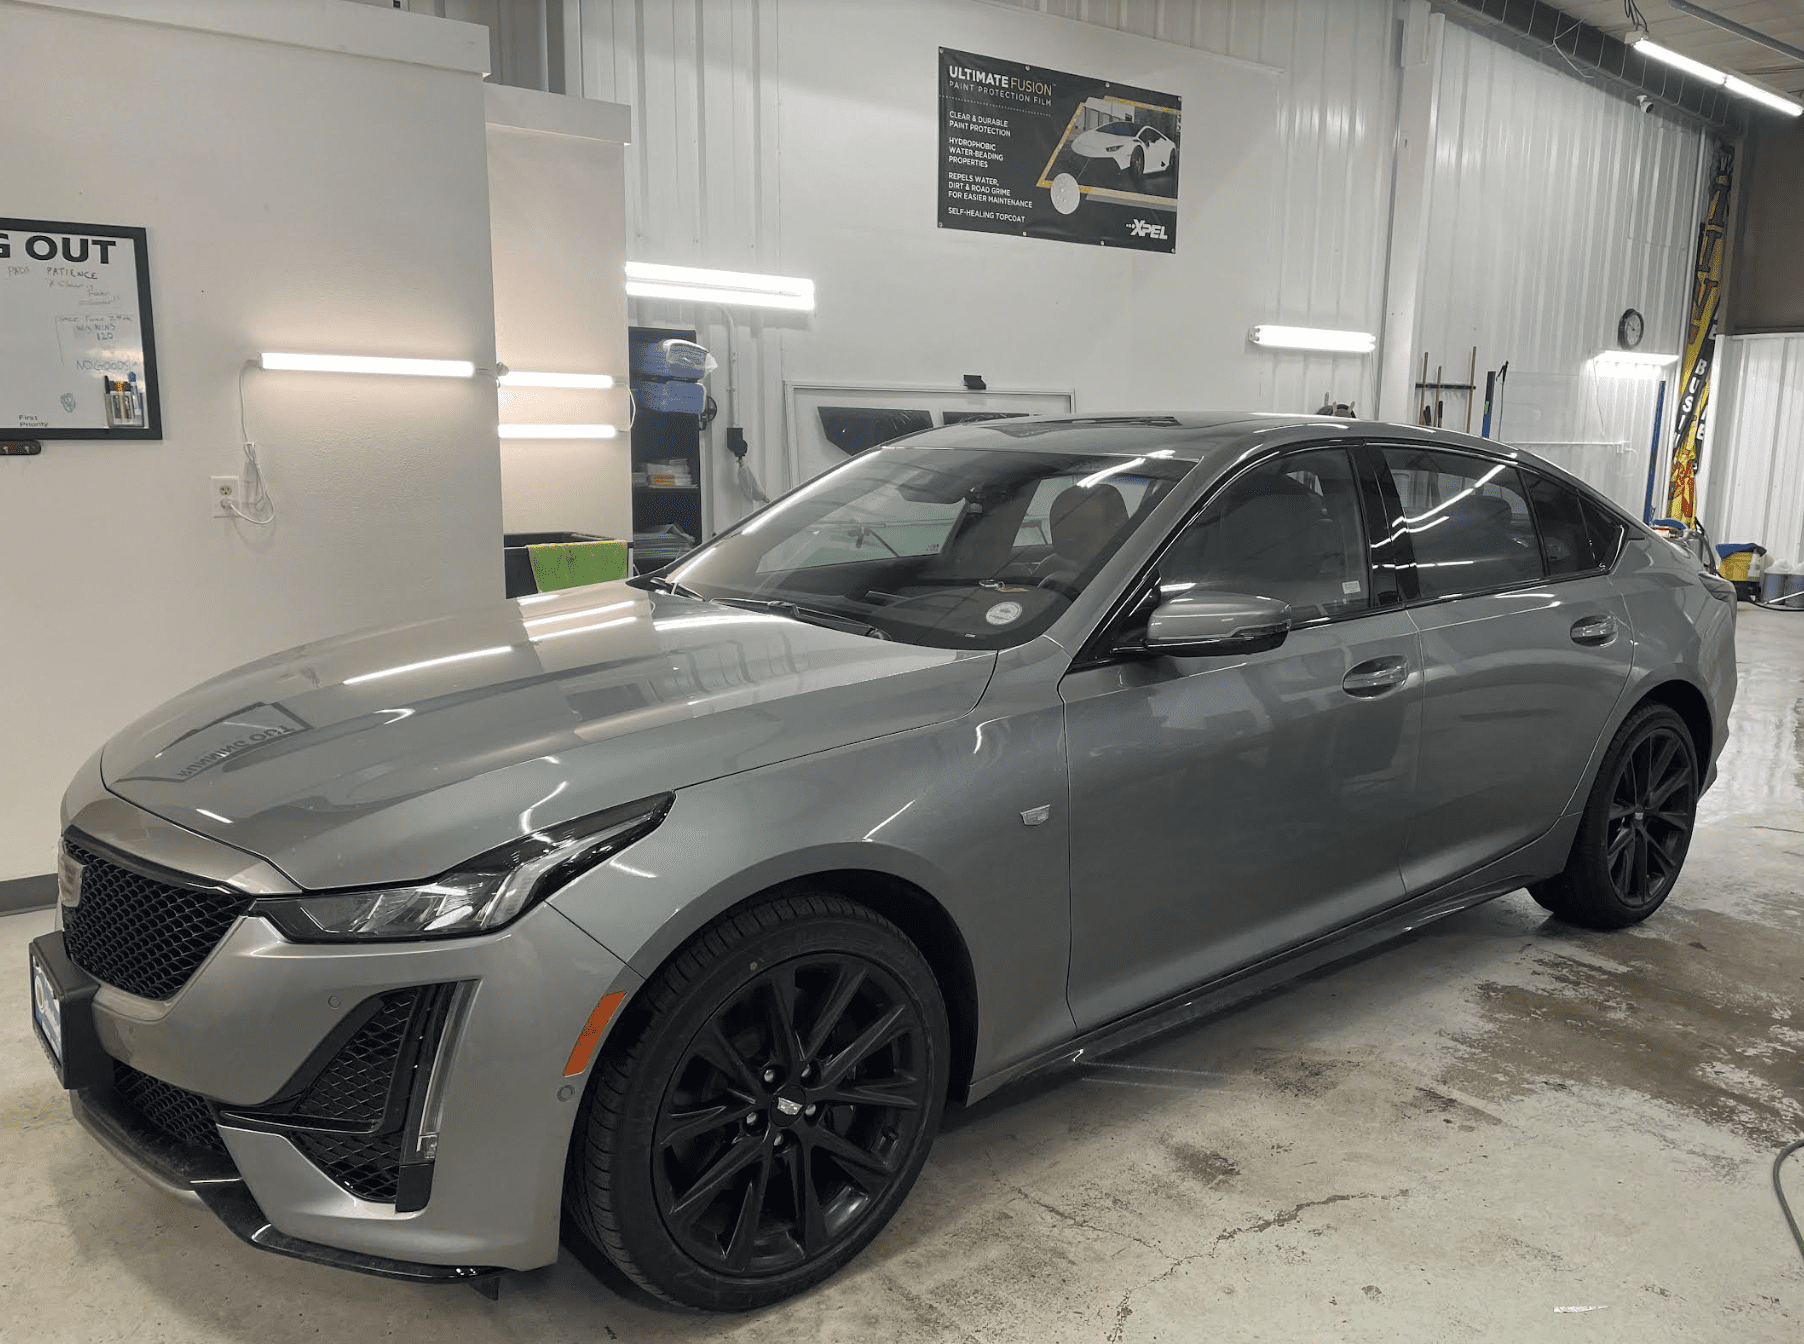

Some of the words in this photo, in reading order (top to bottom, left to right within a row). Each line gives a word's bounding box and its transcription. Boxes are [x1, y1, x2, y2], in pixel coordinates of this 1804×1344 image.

[949, 65, 1009, 88] ULTIMATE
[1010, 77, 1052, 96] FUSION
[949, 80, 975, 92] PAINT
[978, 85, 1030, 102] PROTECTION
[1033, 96, 1052, 107] FILM
[949, 110, 971, 121] CLEAR
[977, 115, 1009, 128] DURABLE
[949, 120, 969, 130] PAINT
[970, 124, 1011, 137] PROTECTION
[949, 137, 996, 151] HYDROPHOBIC
[948, 146, 1004, 162] WATER-BEADING
[948, 155, 988, 168] PROPERTIES
[948, 172, 974, 182] REPELS
[974, 175, 999, 187] WATER,
[948, 181, 964, 190] DIRT
[965, 183, 970, 191] &
[971, 184, 990, 194] ROAD
[991, 187, 1011, 197] GRIME
[948, 190, 962, 199] FOR
[963, 192, 987, 202] EASIER
[988, 196, 1033, 209] MAINTENANCE
[948, 207, 995, 219] SELF-HEALING
[995, 212, 1025, 223] TOPCOAT
[1130, 218, 1168, 239] XPEL
[25, 235, 116, 264] OUT
[46, 267, 98, 279] PATIENCE
